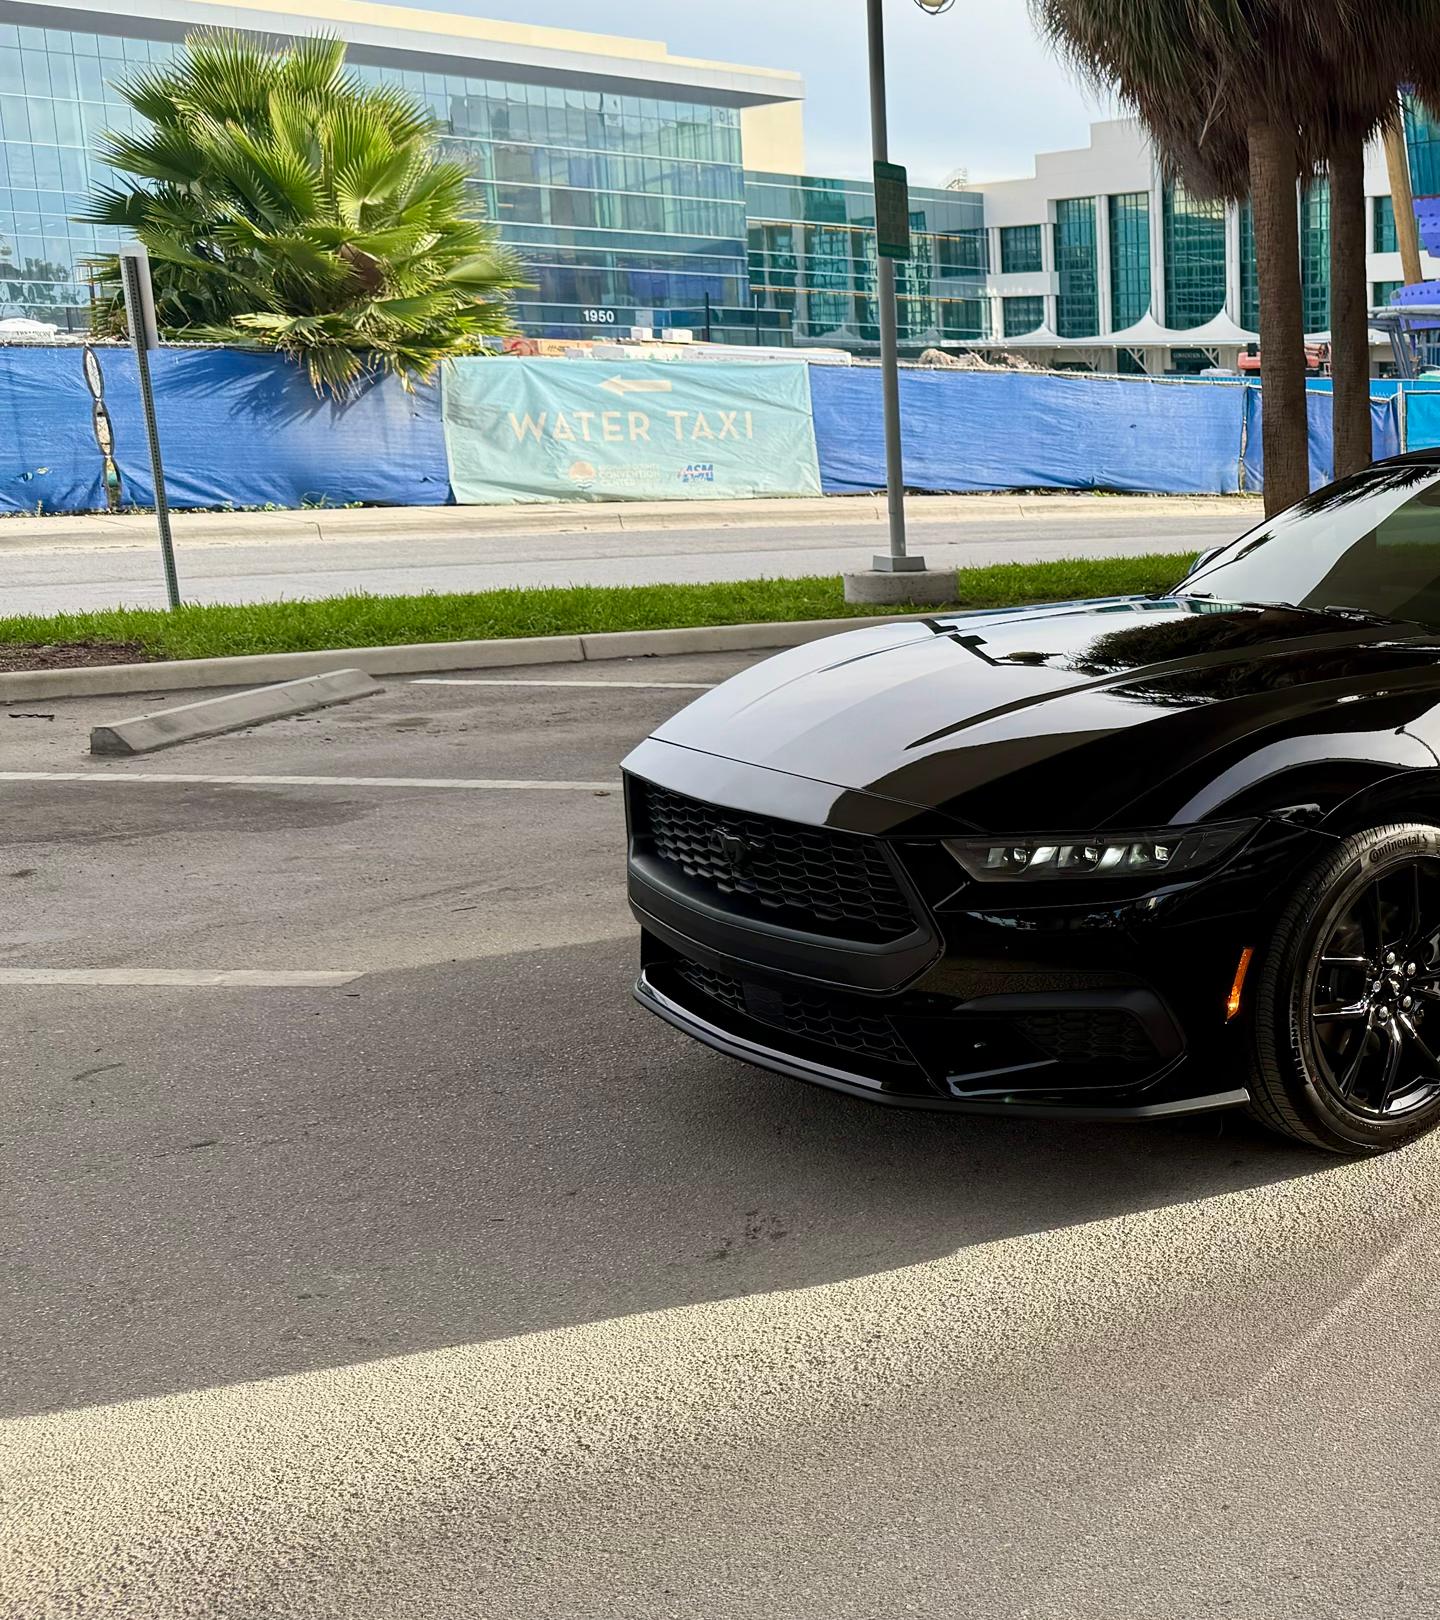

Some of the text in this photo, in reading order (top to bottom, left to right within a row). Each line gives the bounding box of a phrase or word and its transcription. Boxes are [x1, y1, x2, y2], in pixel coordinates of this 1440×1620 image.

[583, 309, 615, 324] 1950
[507, 410, 753, 443] WATER TAXI
[682, 463, 714, 482] ASM
[1369, 833, 1420, 863] Continental
